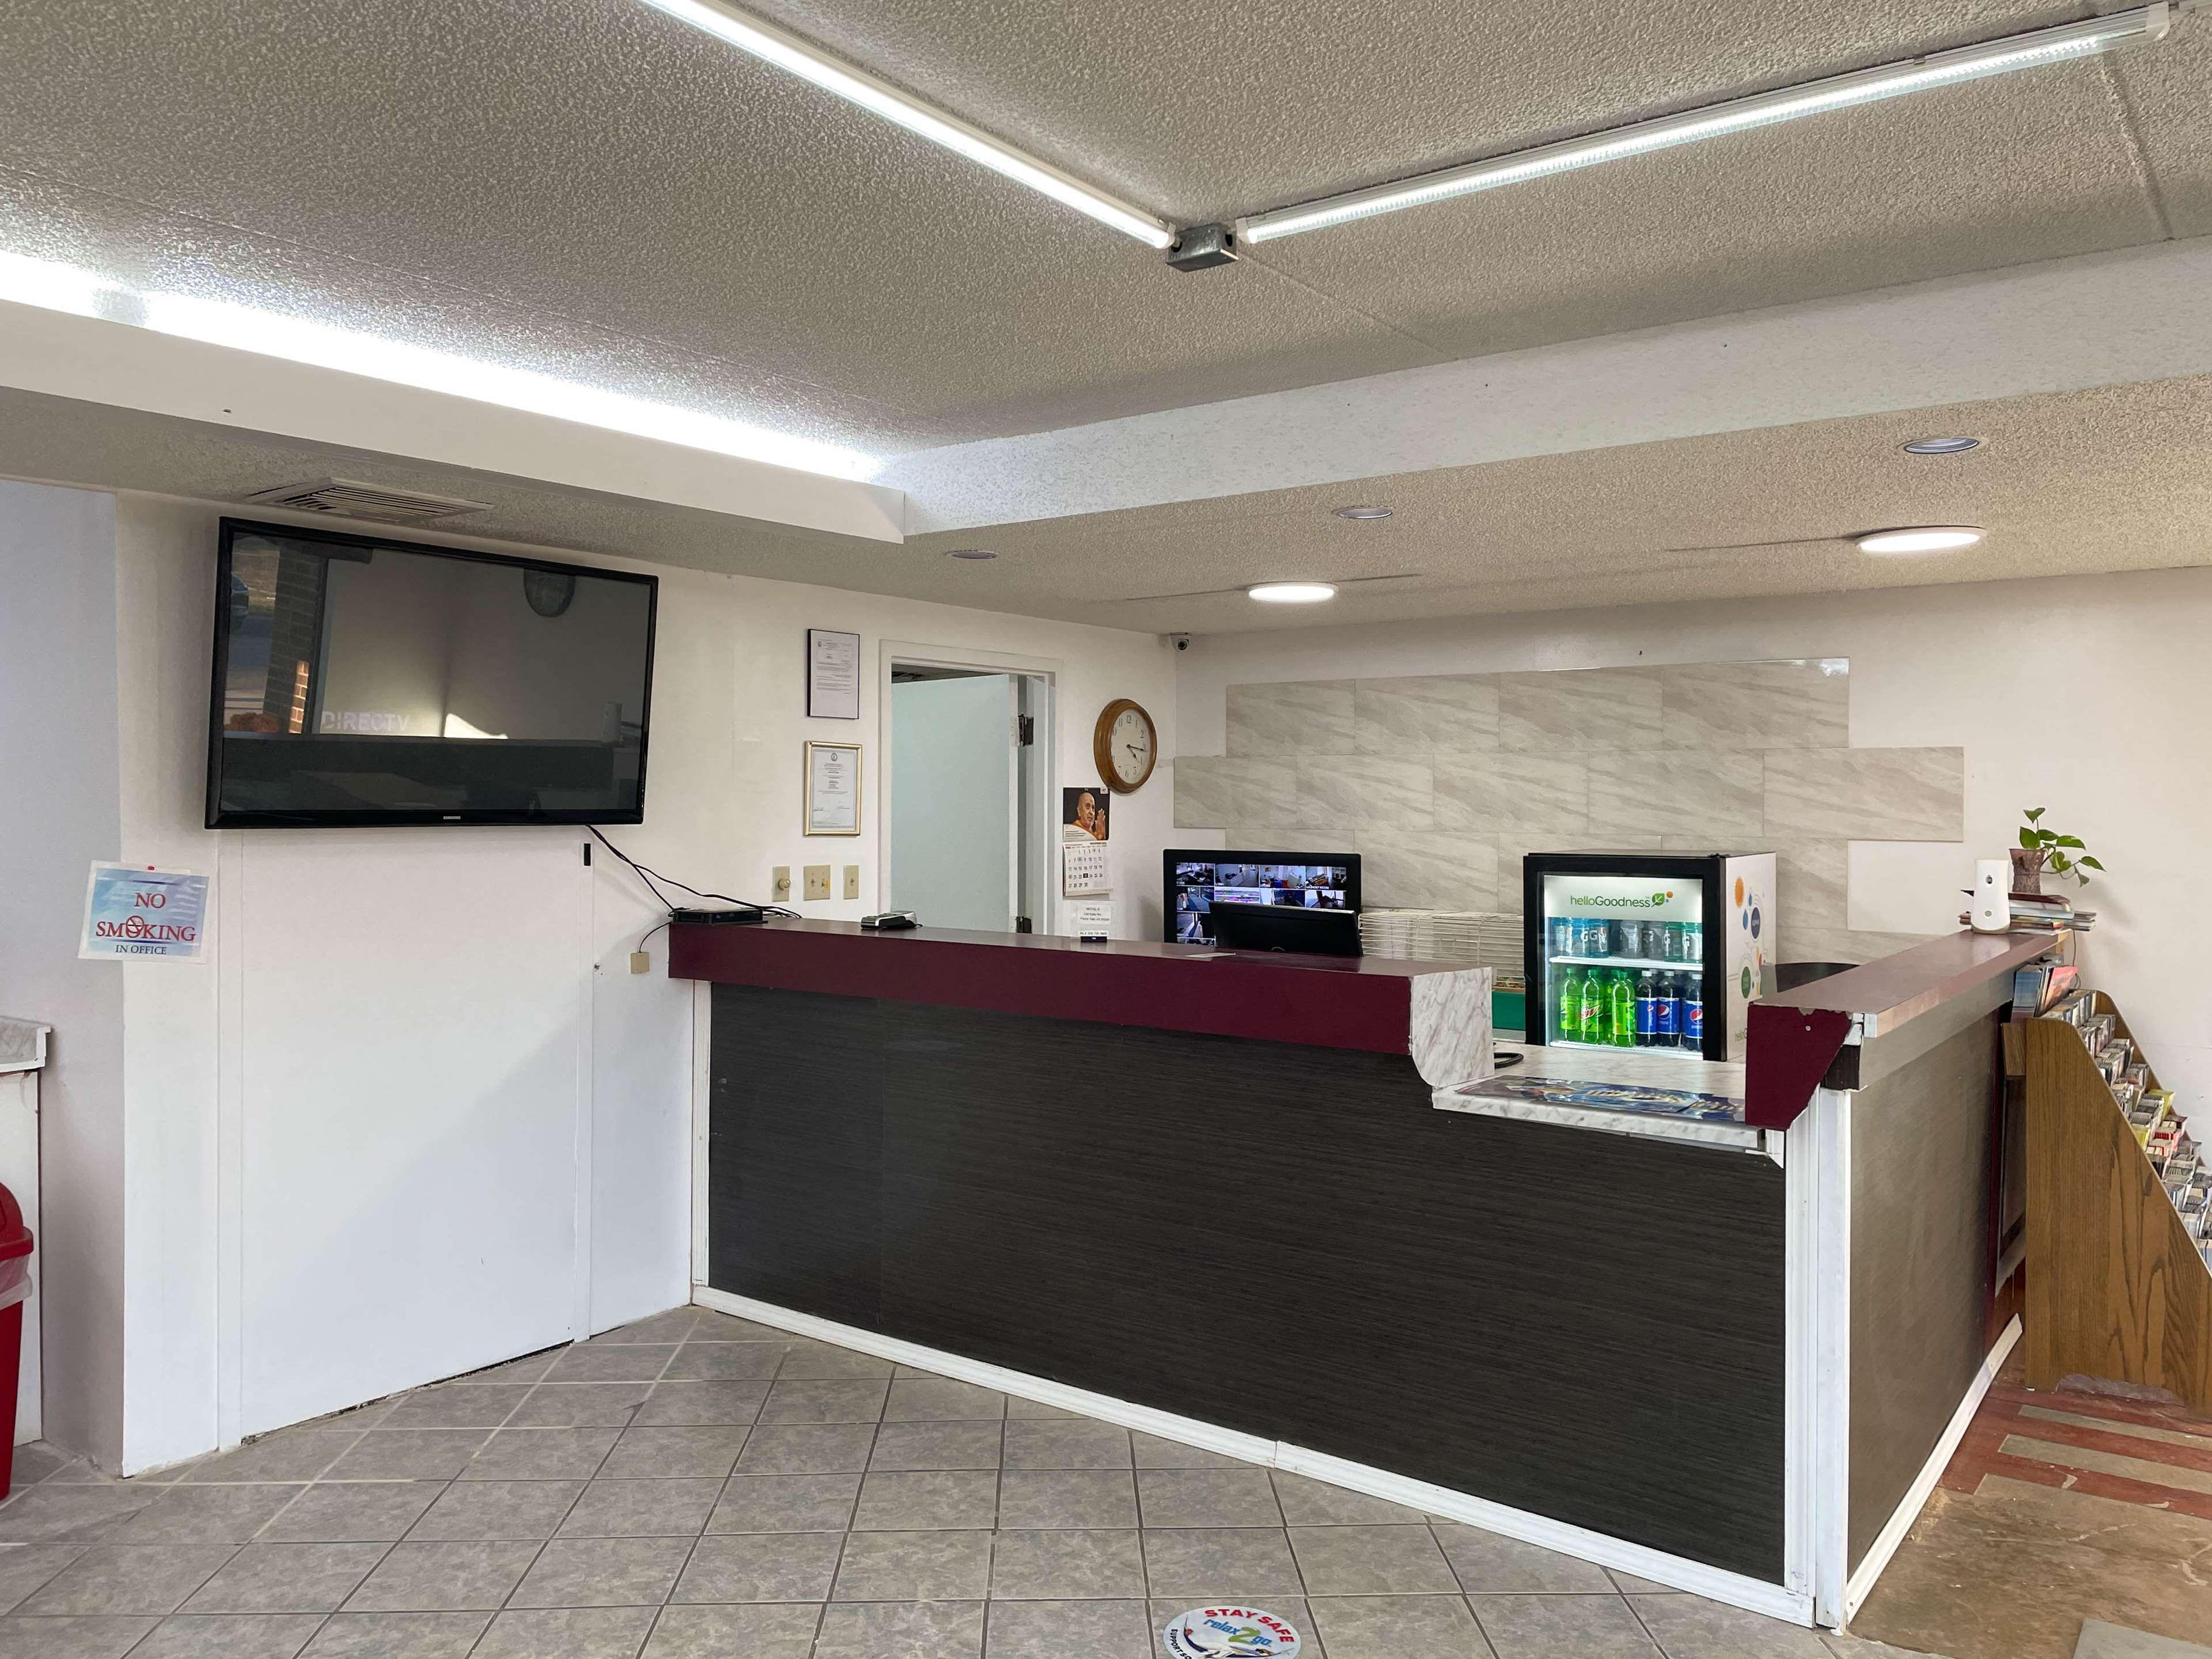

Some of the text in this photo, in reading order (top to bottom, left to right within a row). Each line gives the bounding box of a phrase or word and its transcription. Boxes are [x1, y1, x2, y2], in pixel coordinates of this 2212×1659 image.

[321, 711, 410, 732] DIRECTV
[1126, 715, 1132, 724] 12
[134, 892, 166, 908] NO
[1570, 895, 1650, 907] helloGoodness
[96, 915, 196, 942] SMOKING
[116, 945, 166, 955] IN OFFICE
[1204, 1609, 1295, 1643] STAY SAFE
[1169, 1628, 1184, 1653] SUPPORT
